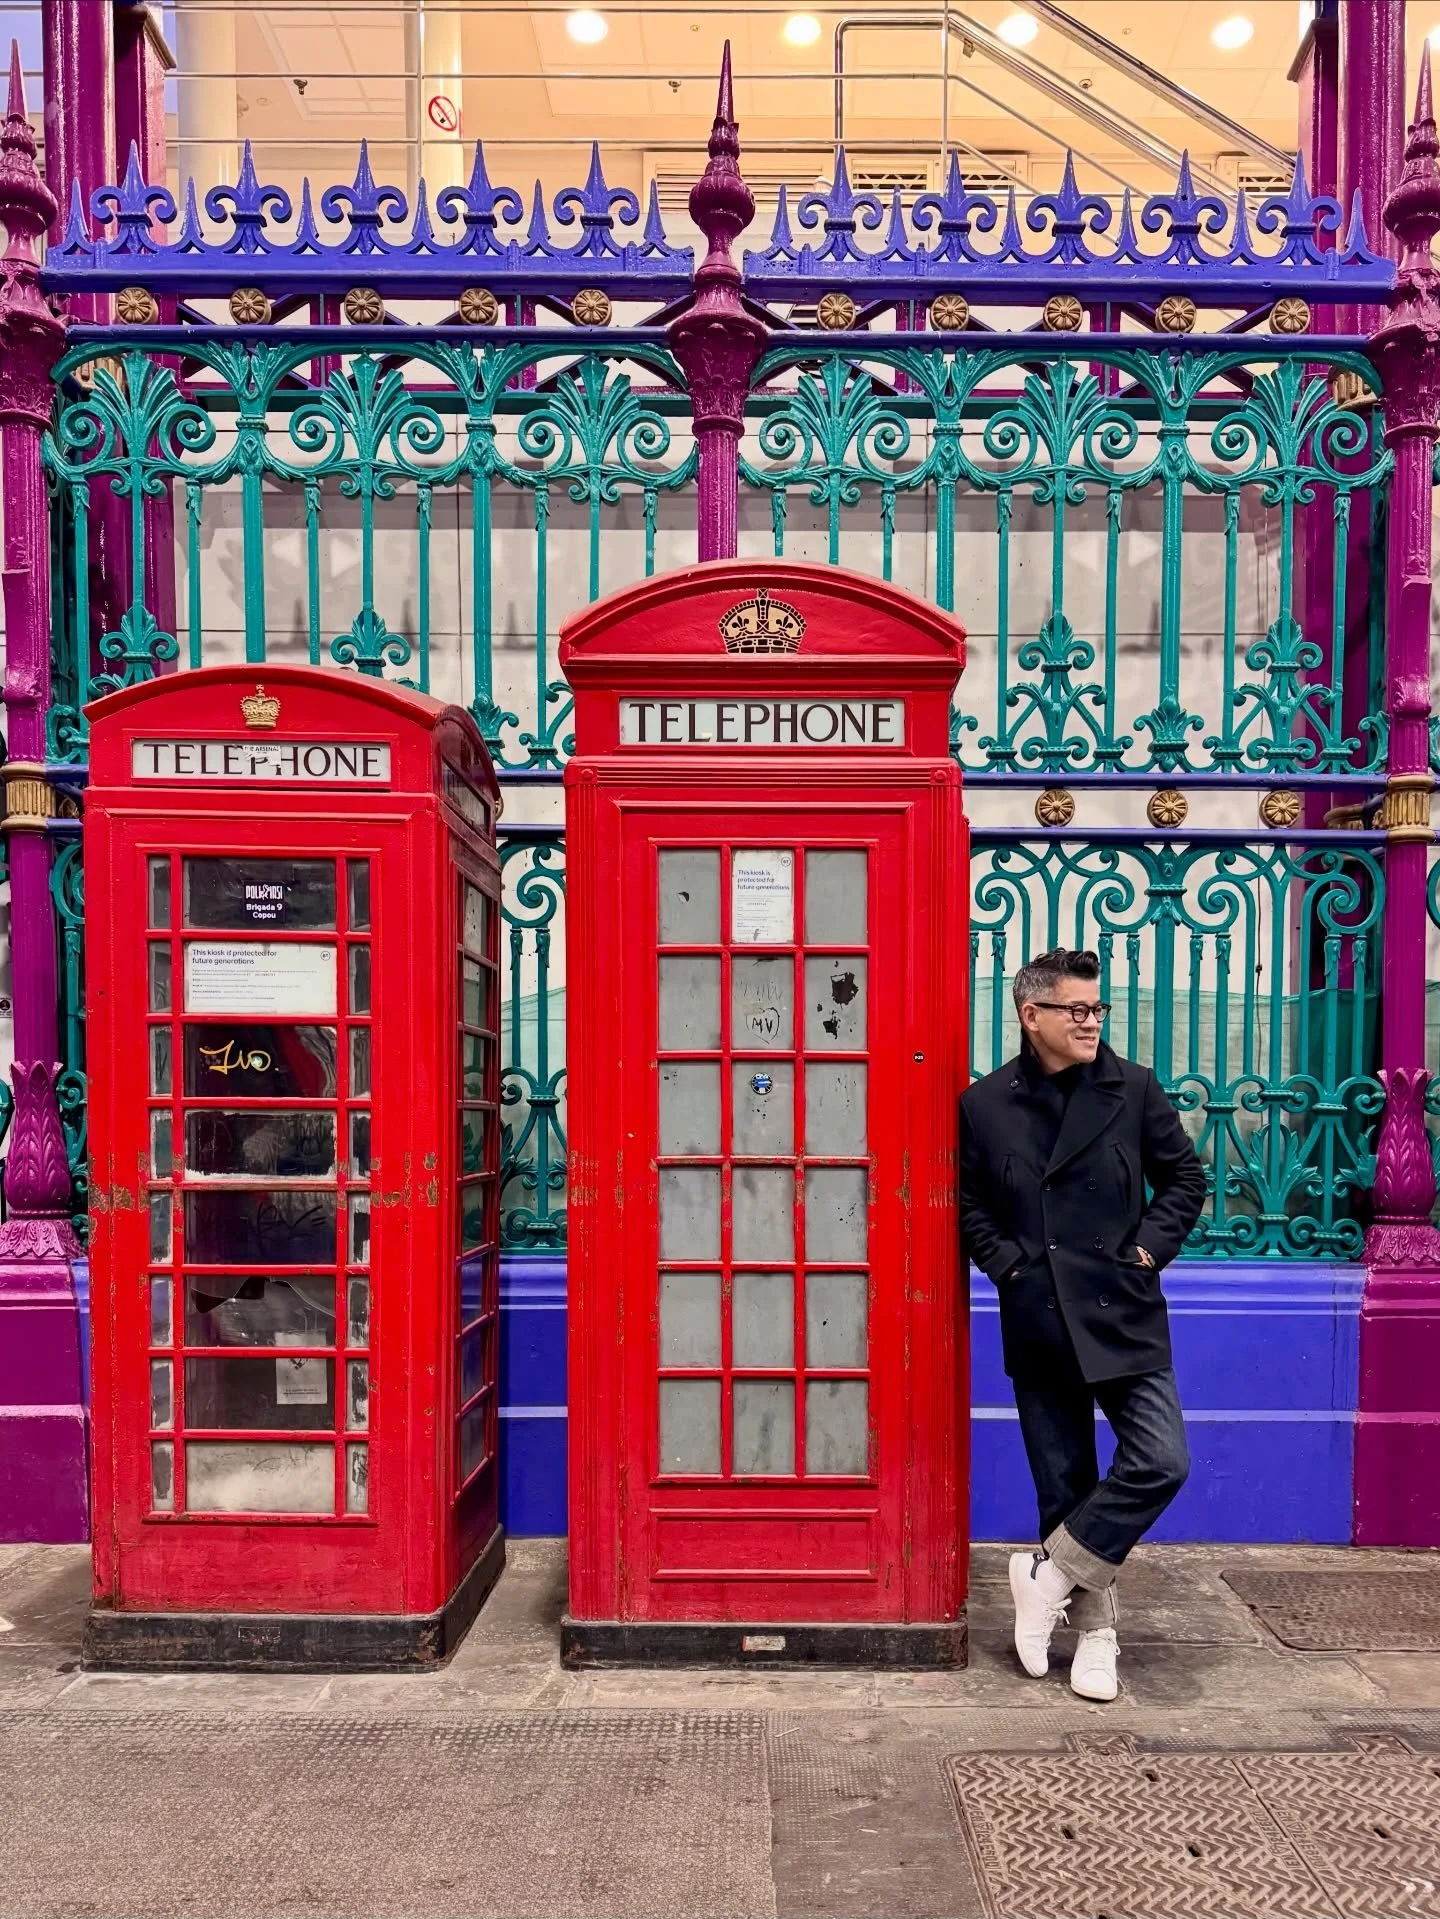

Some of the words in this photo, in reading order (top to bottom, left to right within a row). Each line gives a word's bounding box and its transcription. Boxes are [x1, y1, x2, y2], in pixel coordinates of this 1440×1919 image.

[629, 703, 895, 743] TELEPHONE
[143, 743, 382, 777] TELEPHONE
[246, 903, 275, 912] Brigada
[276, 903, 283, 911] 9
[252, 911, 276, 920] Copou
[232, 949, 267, 957] protected
[214, 958, 255, 966] generations
